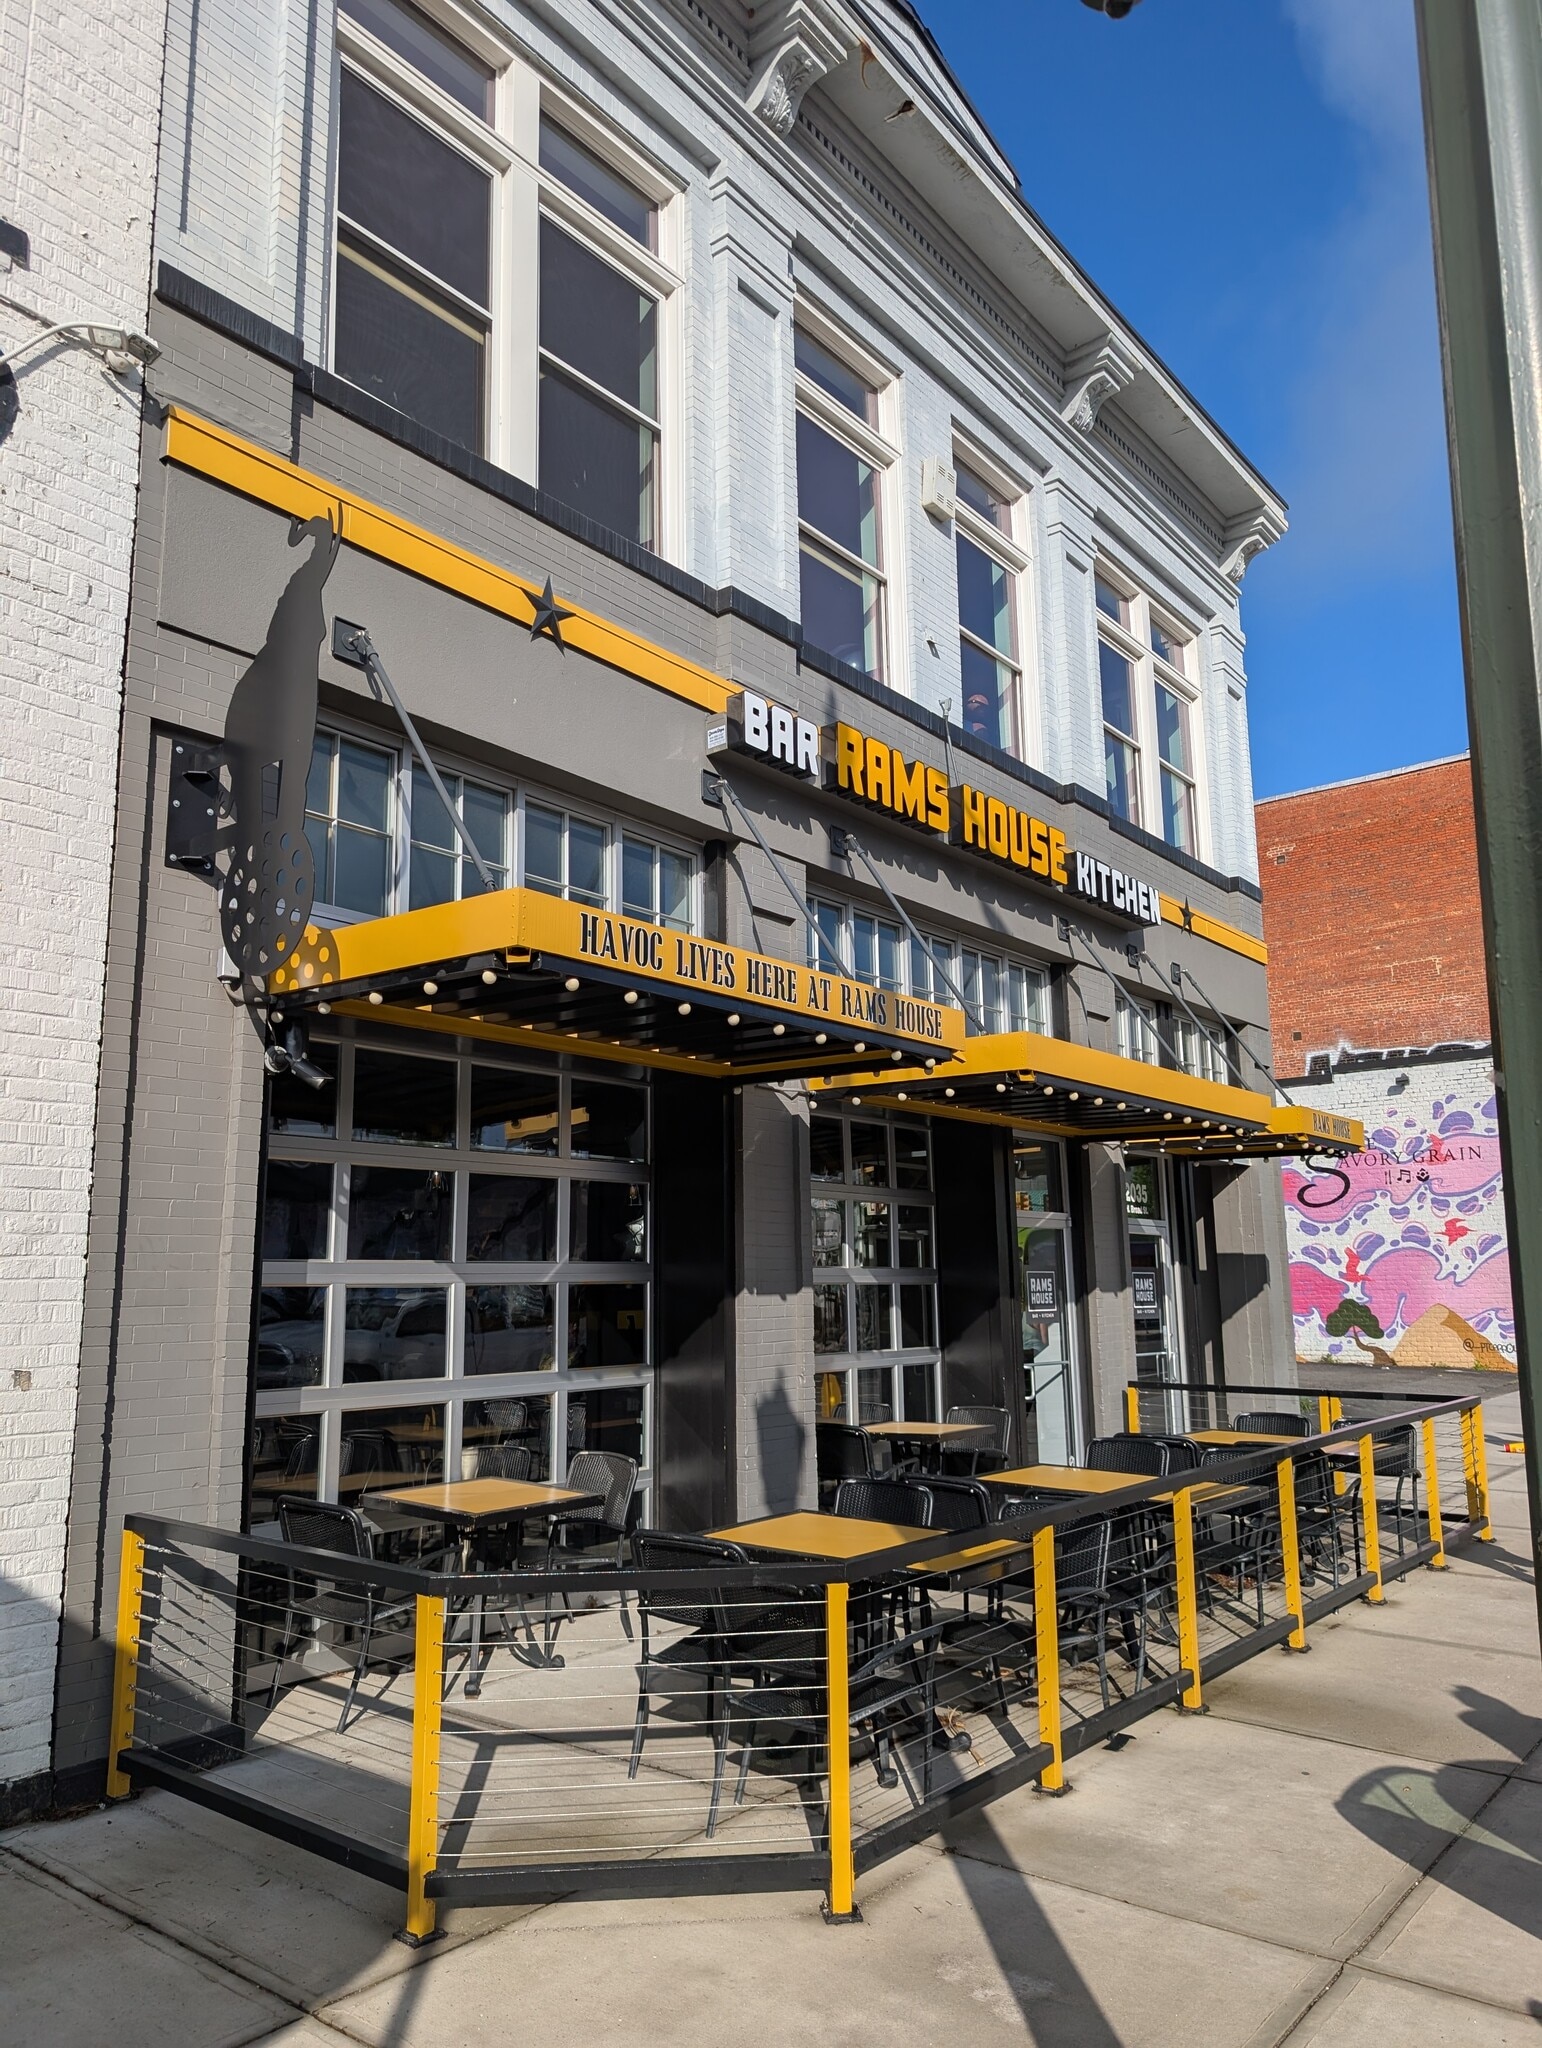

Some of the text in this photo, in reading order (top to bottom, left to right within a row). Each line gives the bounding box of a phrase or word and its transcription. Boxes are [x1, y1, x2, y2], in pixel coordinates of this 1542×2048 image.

[744, 690, 1162, 926] BAR RAMS HOUSE KITCHEN
[579, 911, 943, 1040] HAVOC LIVES HERE AT RAMS HOUSE
[1313, 1112, 1351, 1139] RAMS HOUSE
[1412, 1145, 1482, 1164] GRAIN
[1125, 1182, 1148, 1203] 2035
[1030, 1278, 1053, 1292] RAMS
[1135, 1278, 1154, 1290] RAMS
[1031, 1292, 1054, 1304] HOUSE
[1136, 1291, 1154, 1302] HOUSE
